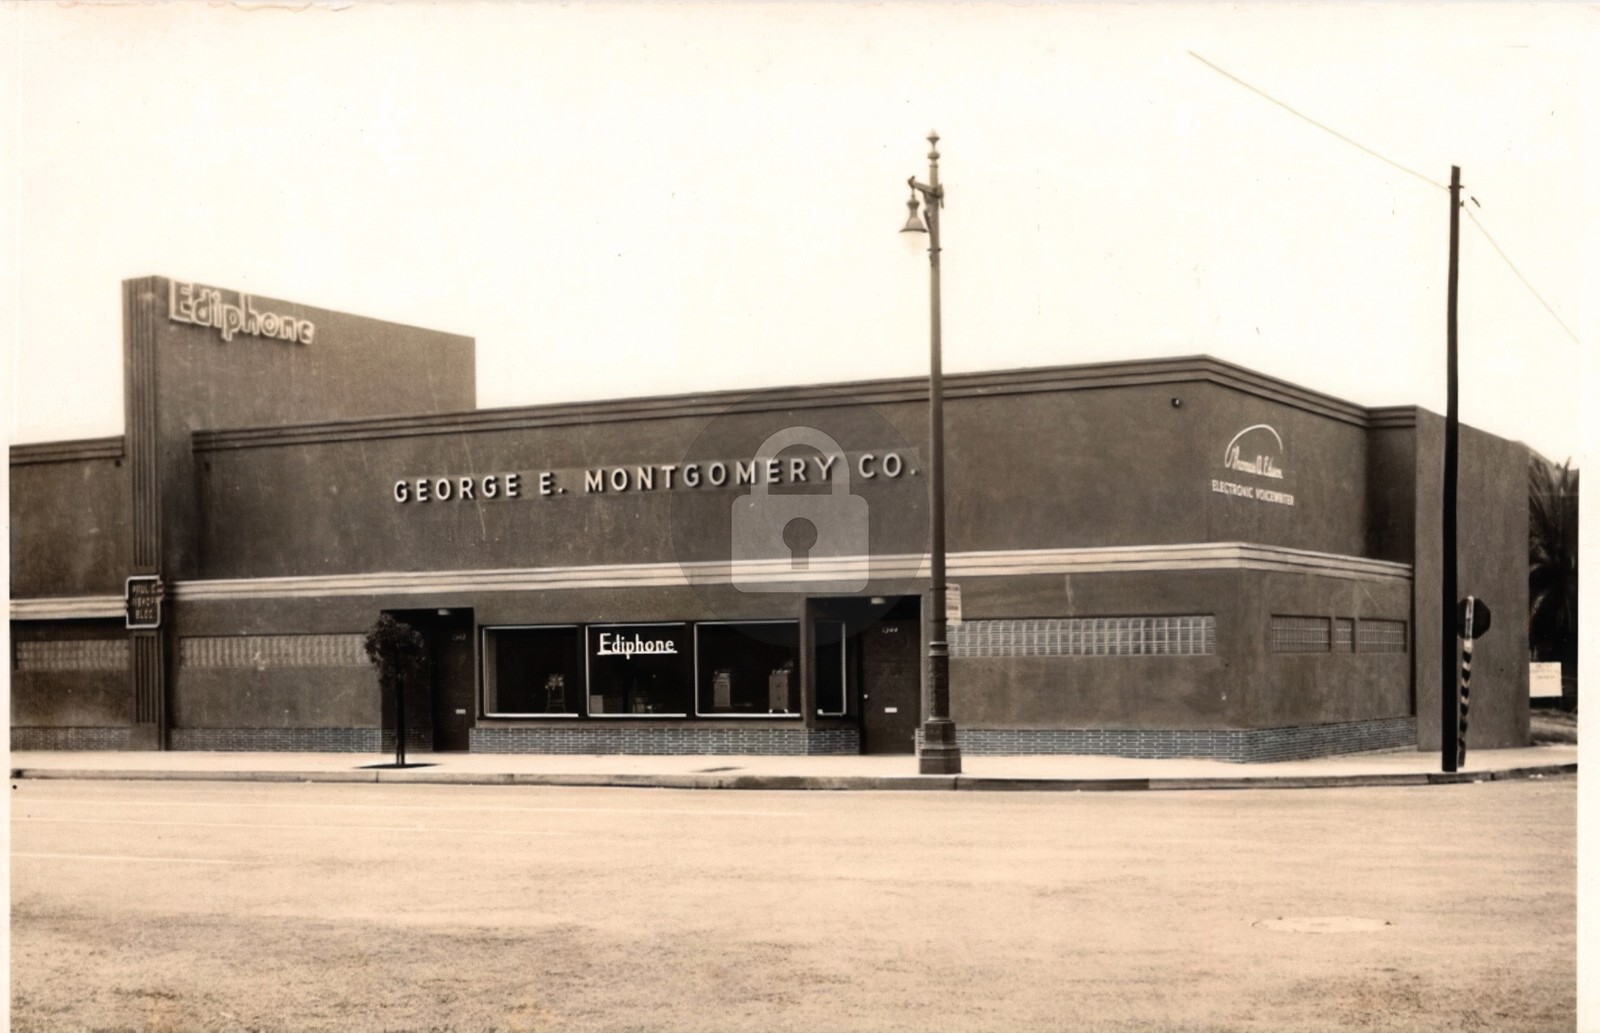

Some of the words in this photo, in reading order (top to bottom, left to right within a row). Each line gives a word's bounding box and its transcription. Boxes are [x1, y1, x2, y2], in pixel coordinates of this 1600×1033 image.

[169, 279, 315, 345] Ediphone
[393, 474, 519, 503] GEORGE
[539, 471, 566, 495] E.
[584, 455, 838, 493] MONTGOMERY
[858, 452, 919, 479] CO.
[597, 632, 678, 660] Ediphone
